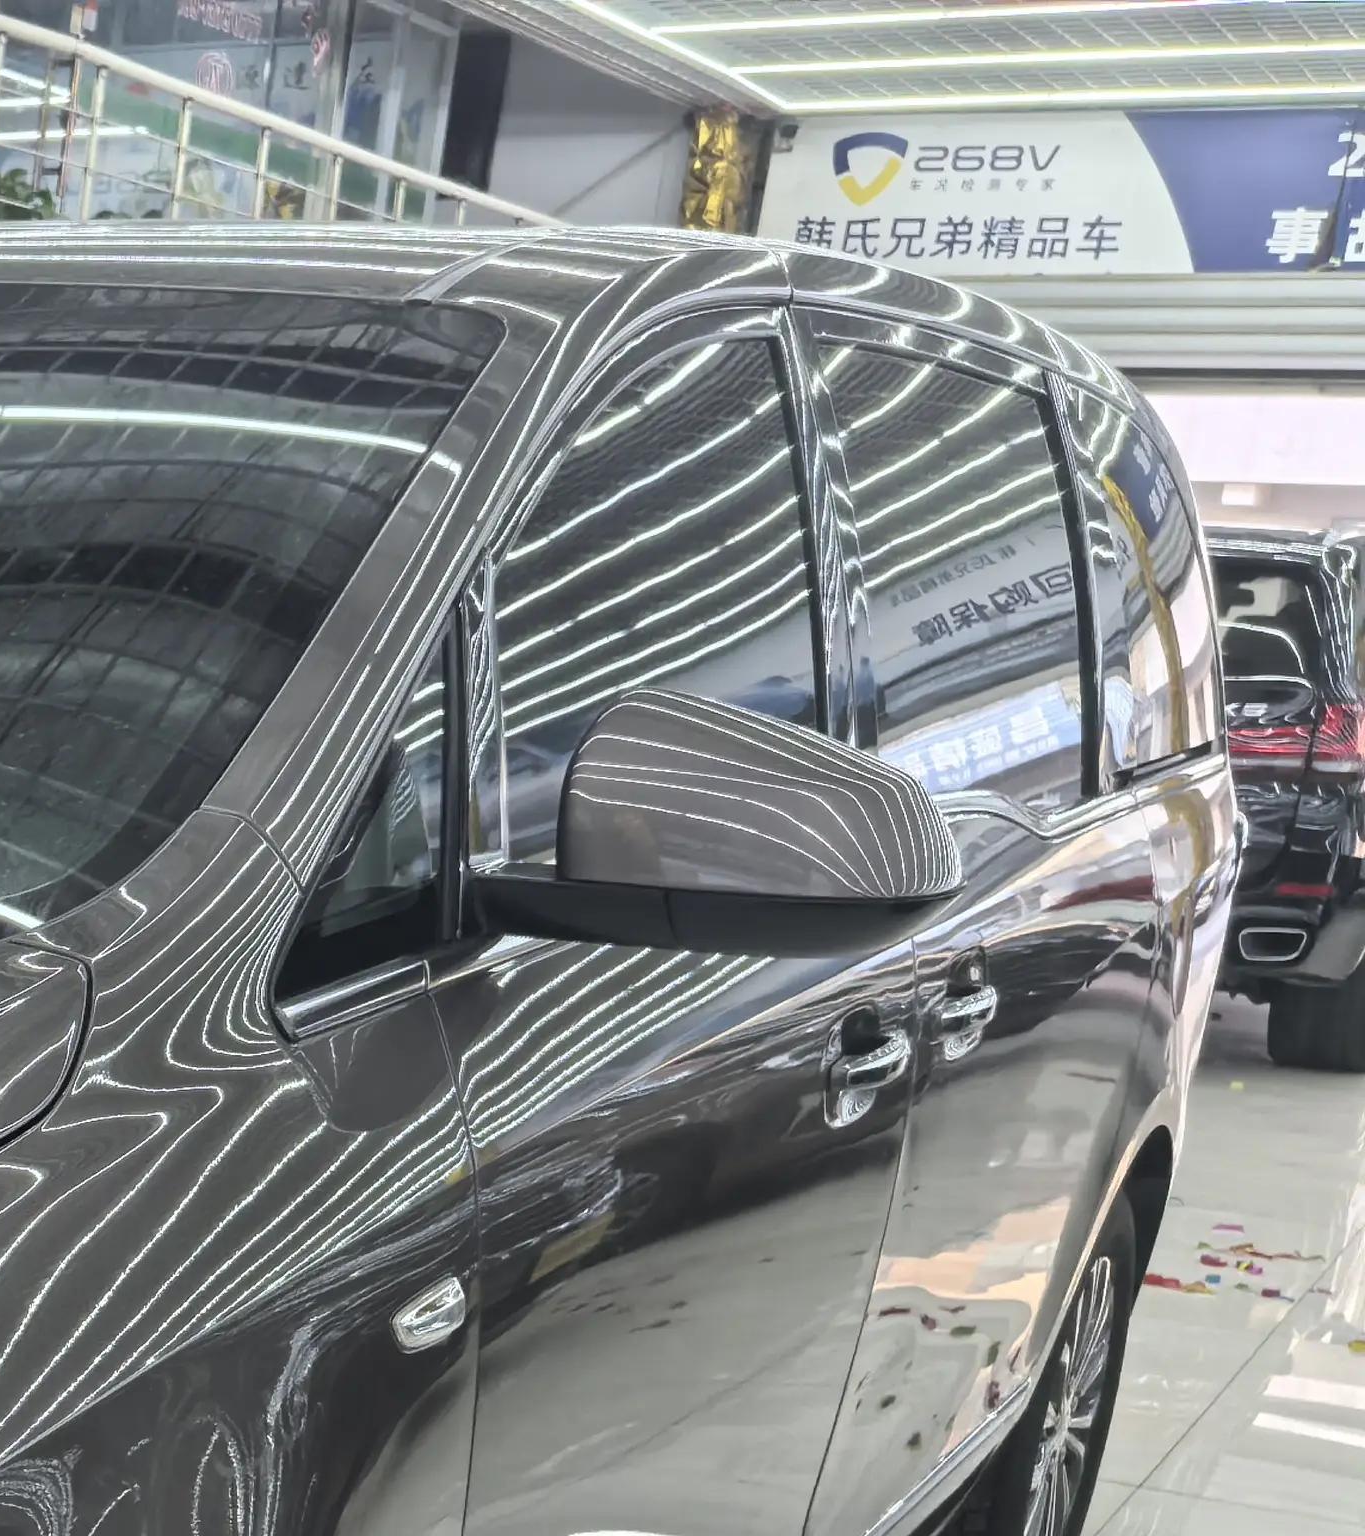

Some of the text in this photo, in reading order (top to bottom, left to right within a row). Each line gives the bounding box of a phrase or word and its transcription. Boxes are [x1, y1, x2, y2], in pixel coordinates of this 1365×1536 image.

[914, 144, 1061, 172] 268V
[794, 215, 1123, 262] 韩氏兄弟精品车
